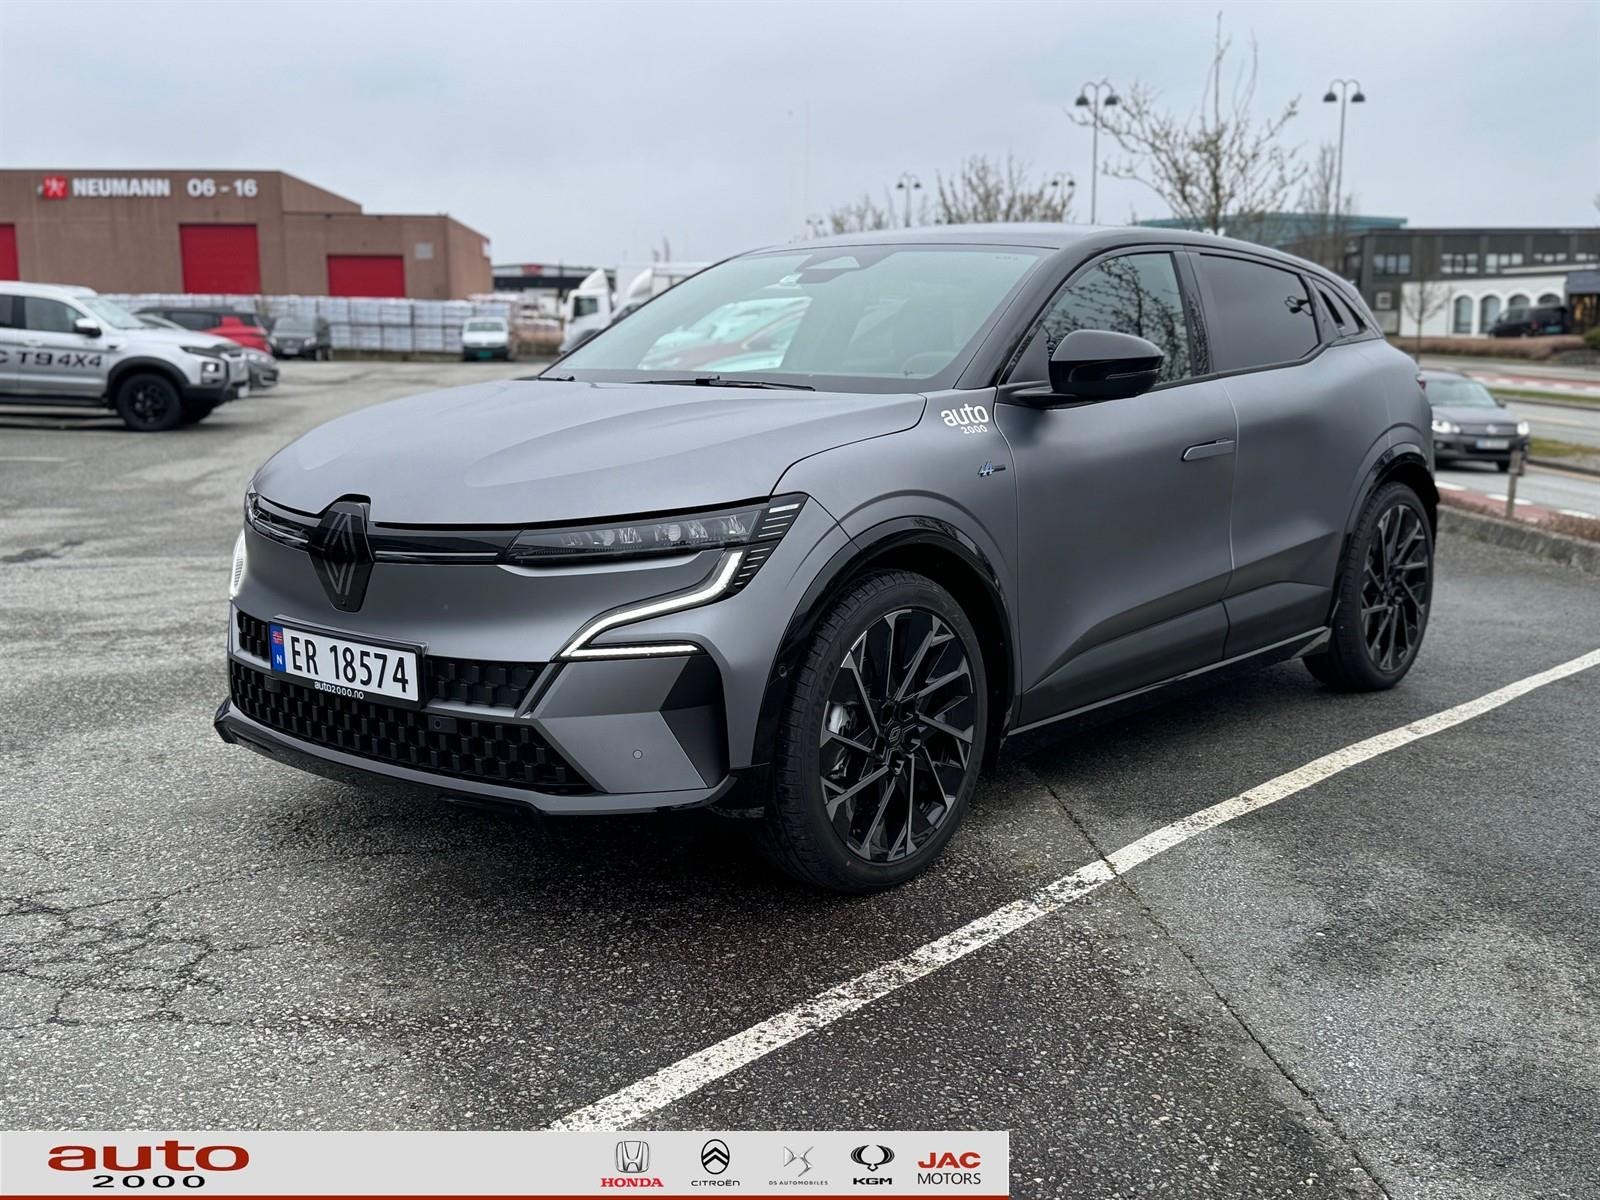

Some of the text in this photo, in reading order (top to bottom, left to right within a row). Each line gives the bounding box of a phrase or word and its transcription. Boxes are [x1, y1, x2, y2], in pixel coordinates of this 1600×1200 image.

[72, 178, 171, 197] NEUMANN
[187, 178, 217, 197] 06
[233, 178, 258, 197] 16
[940, 403, 990, 427] auto
[960, 424, 988, 434] 2000
[276, 654, 283, 665] N
[290, 635, 409, 693] ER 18574
[314, 681, 365, 700] auto2000.no
